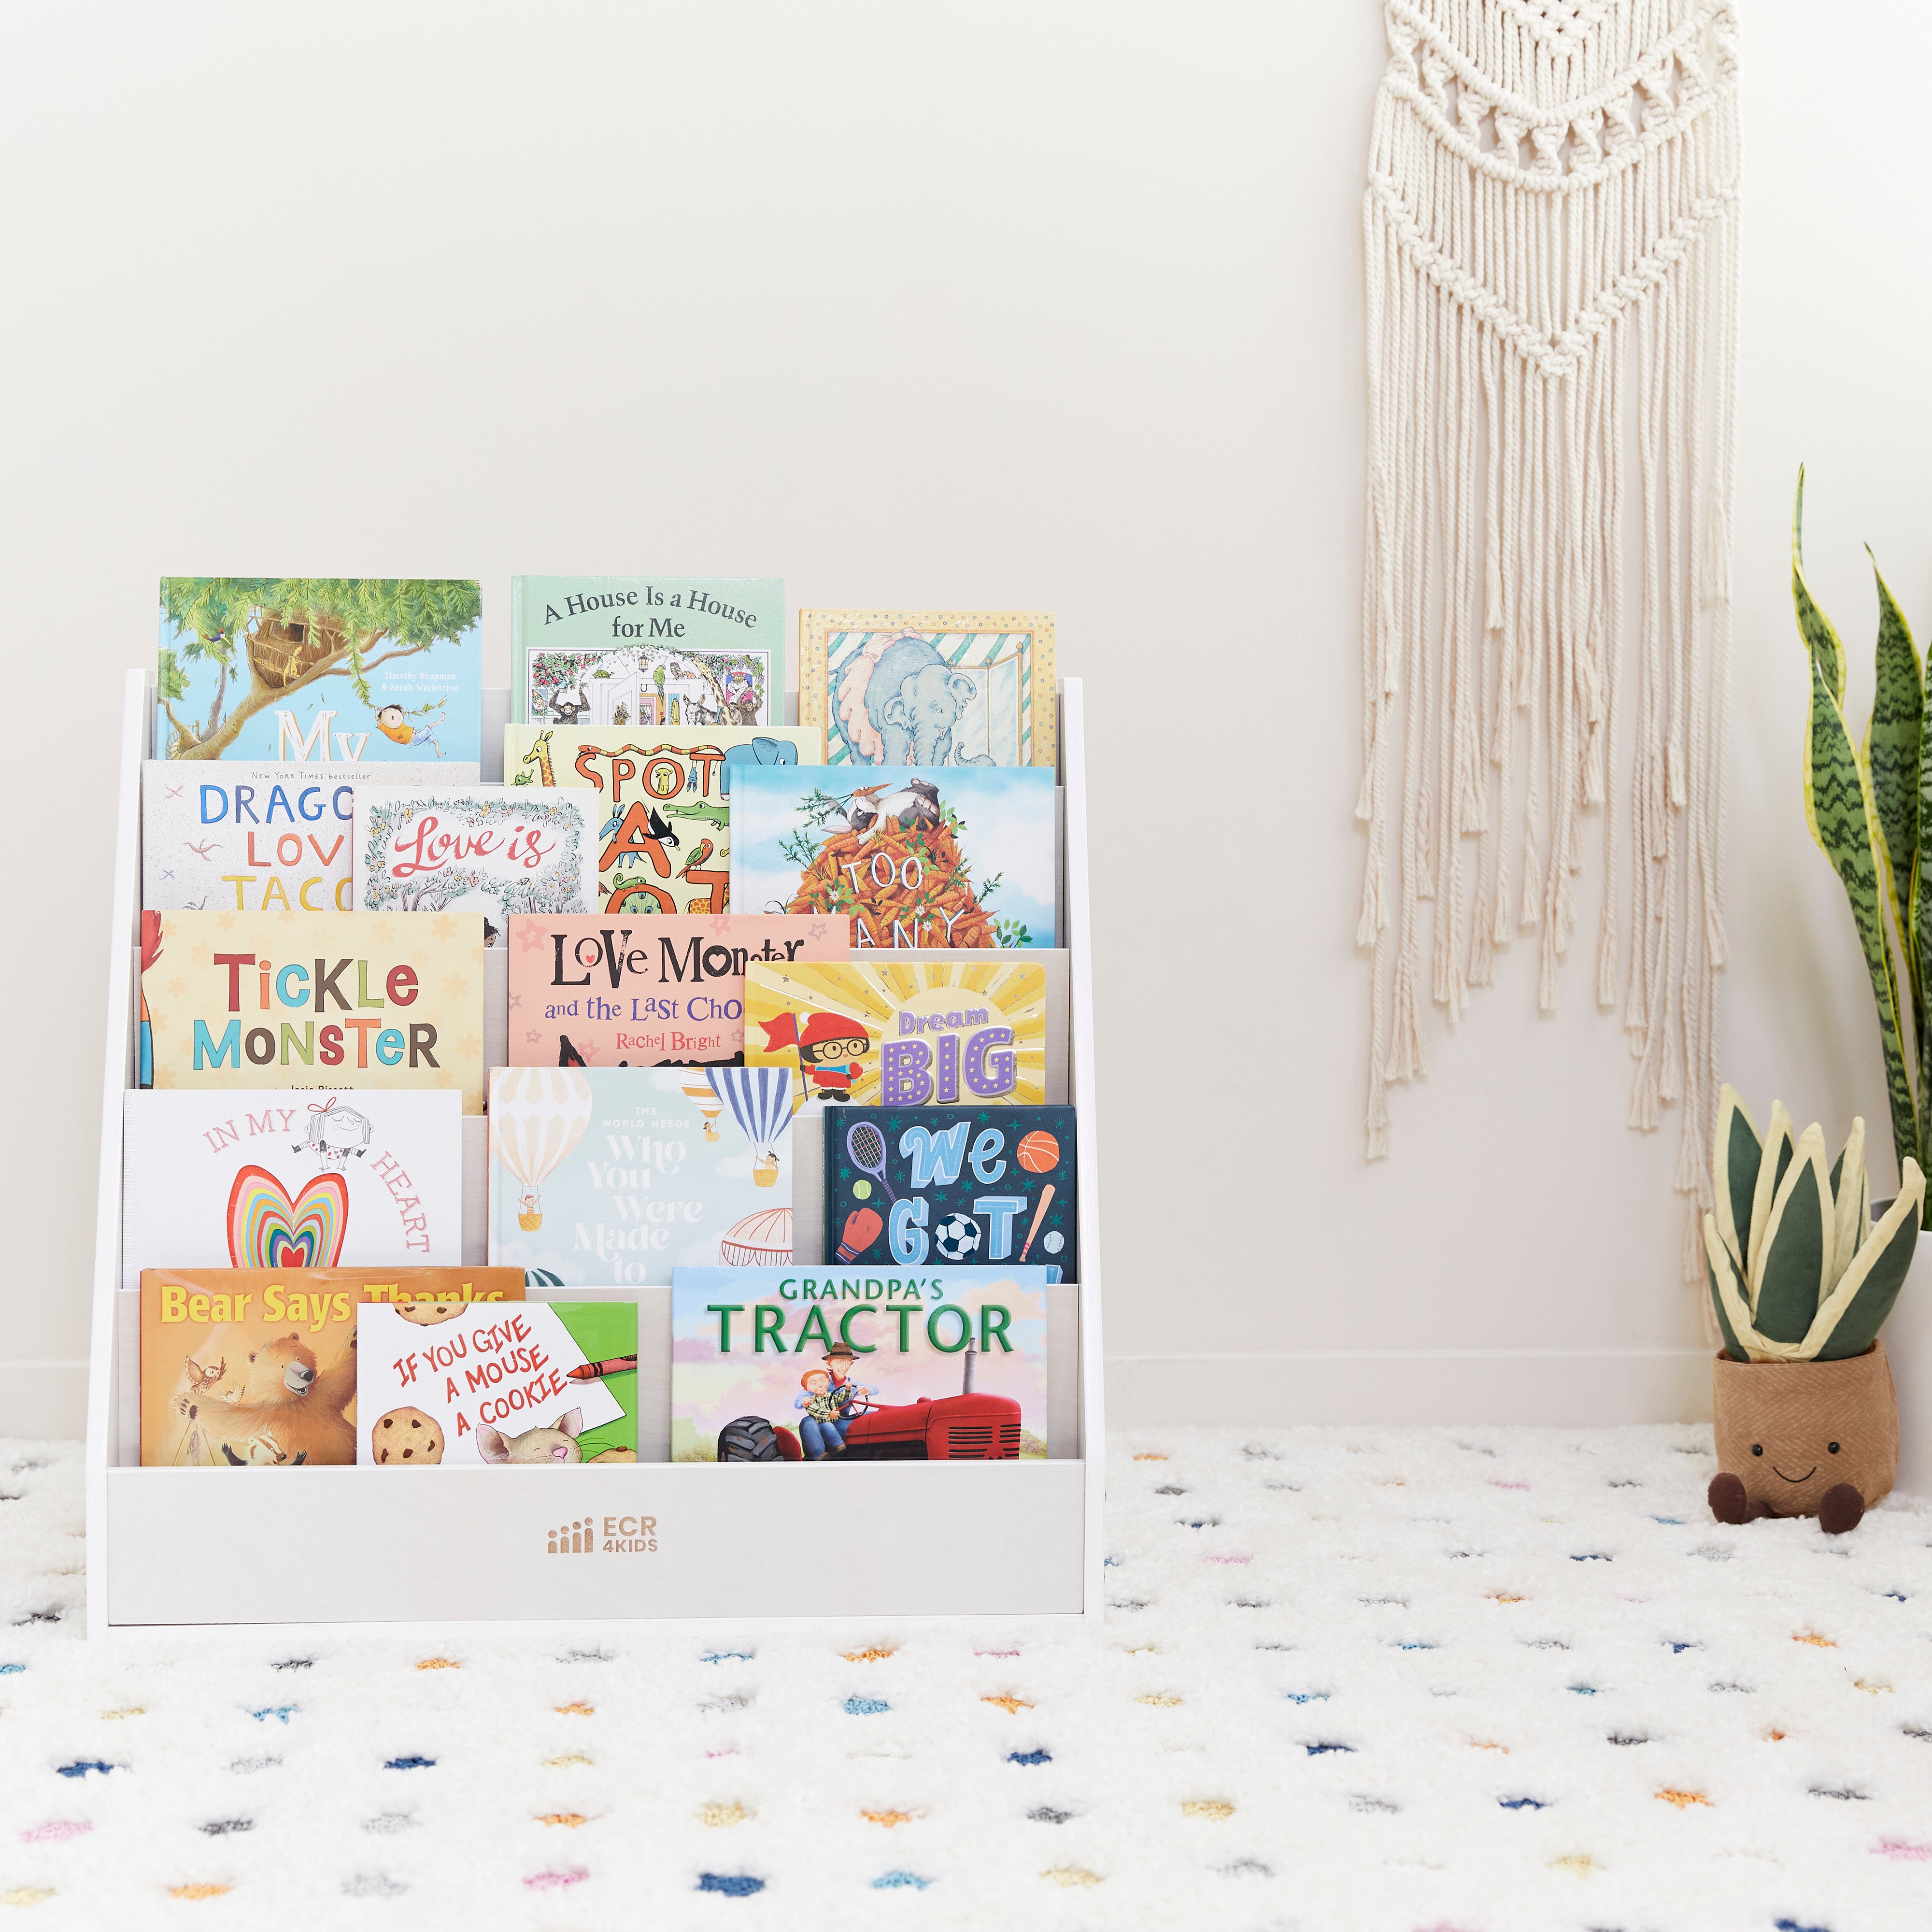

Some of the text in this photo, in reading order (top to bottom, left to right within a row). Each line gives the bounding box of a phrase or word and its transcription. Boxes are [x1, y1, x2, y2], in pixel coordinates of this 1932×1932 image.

[543, 586, 757, 628] A House Is a House
[611, 616, 685, 637] for Me
[384, 672, 456, 682] Timothy Knapman
[390, 683, 412, 691] Sarah
[416, 683, 459, 691] Warburton
[575, 753, 725, 802] SPOT
[392, 816, 556, 878] Love is
[599, 801, 671, 879] A
[840, 852, 922, 894] TOO
[812, 905, 965, 948] ANY
[544, 1000, 579, 1019] and
[586, 996, 621, 1019] the
[630, 996, 679, 1021] Last
[899, 1007, 989, 1037] Dream
[615, 1031, 721, 1051] Rachel Bright
[880, 1026, 1017, 1106] BIG
[606, 1135, 686, 1174] Who
[203, 1109, 429, 1252] IN MY HEART
[587, 1162, 650, 1188] You
[612, 1195, 703, 1222] Were
[573, 1223, 669, 1262] Made
[160, 1285, 253, 1323] Bear
[263, 1285, 351, 1332] Says
[780, 1279, 943, 1300] GRANDPA'S
[708, 1304, 1014, 1353] TRACTOR
[393, 1314, 531, 1388] IF YOU GIVE
[447, 1344, 549, 1404] A MOUSE
[457, 1368, 567, 1436] A COOKIE
[603, 1539, 658, 1552] 4KIDS
[604, 1516, 656, 1536] ECR
